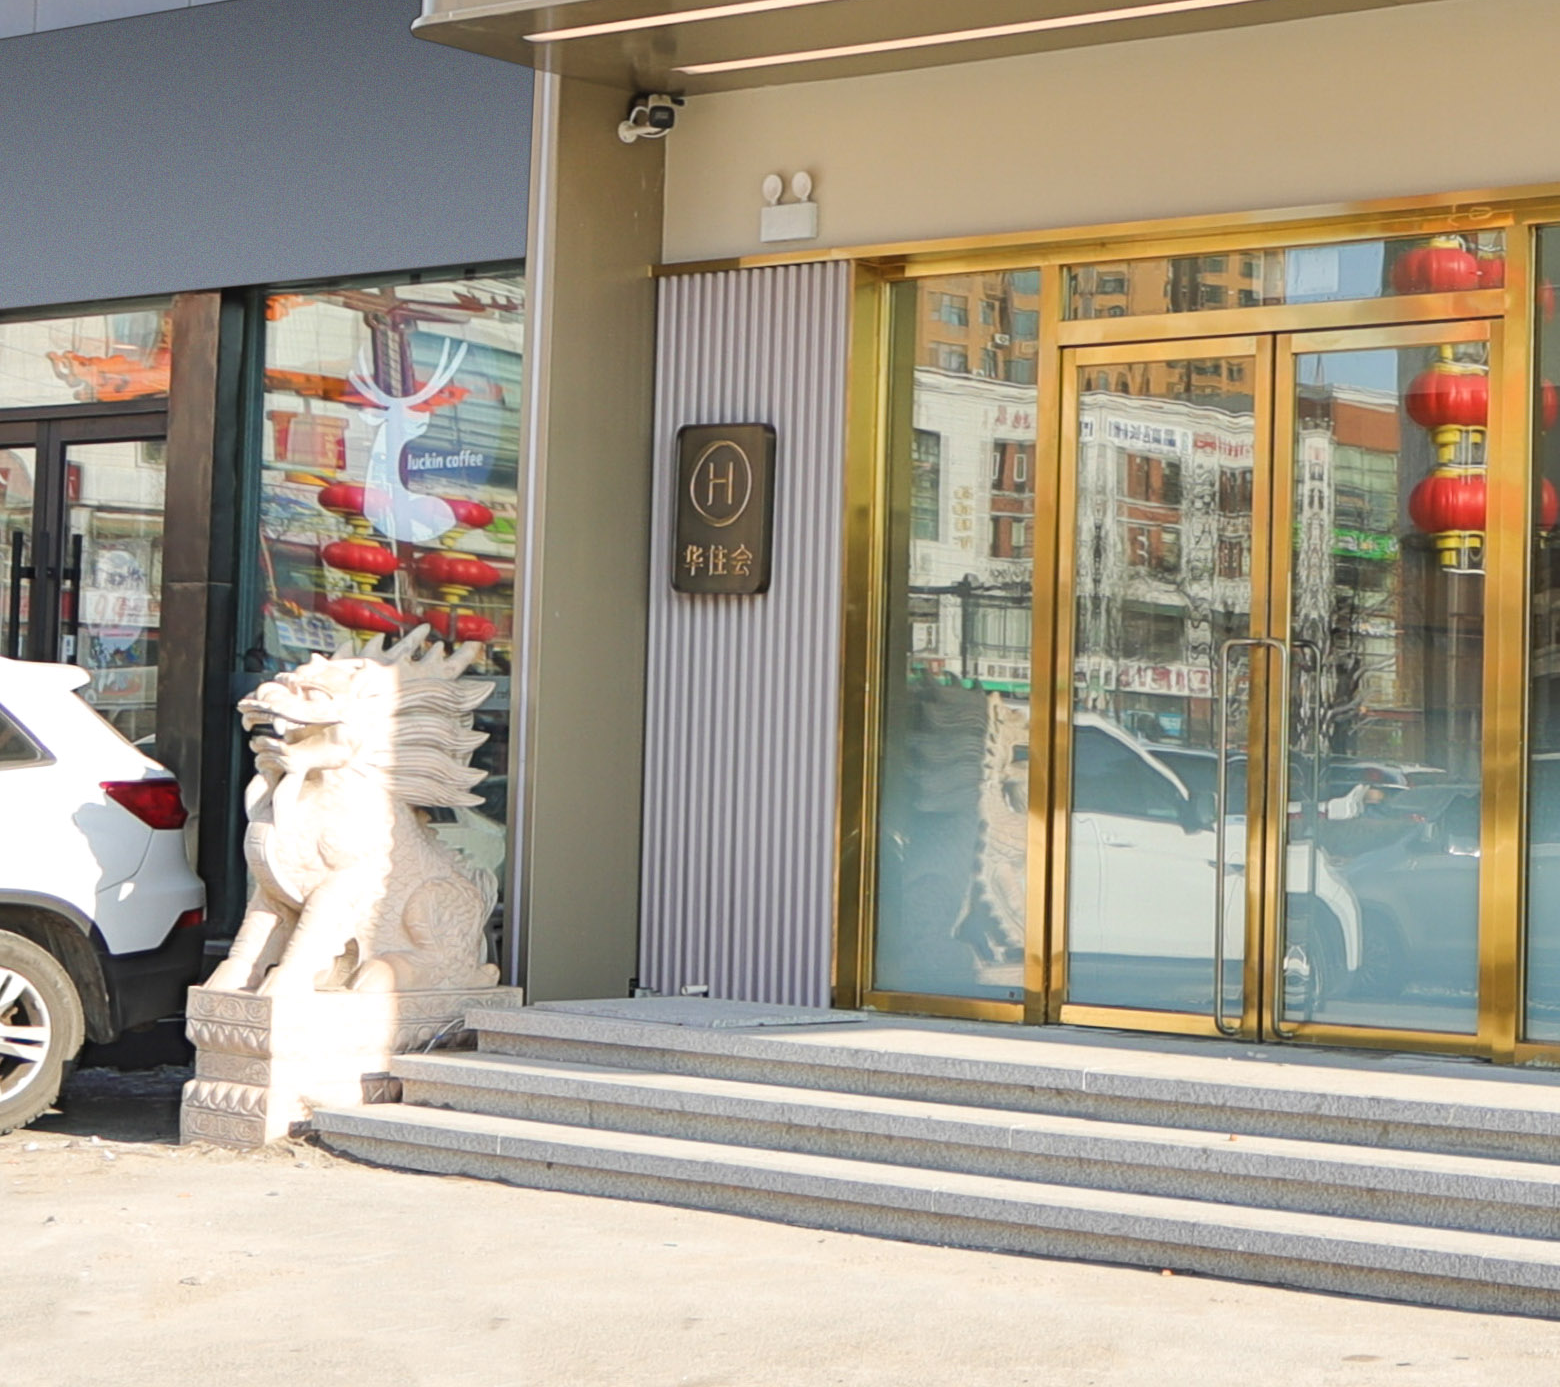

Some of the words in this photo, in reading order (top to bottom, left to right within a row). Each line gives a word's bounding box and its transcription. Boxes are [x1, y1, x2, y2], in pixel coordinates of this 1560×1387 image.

[407, 452, 443, 471] luckin
[446, 449, 484, 469] coffee
[683, 543, 753, 577] 华住会
